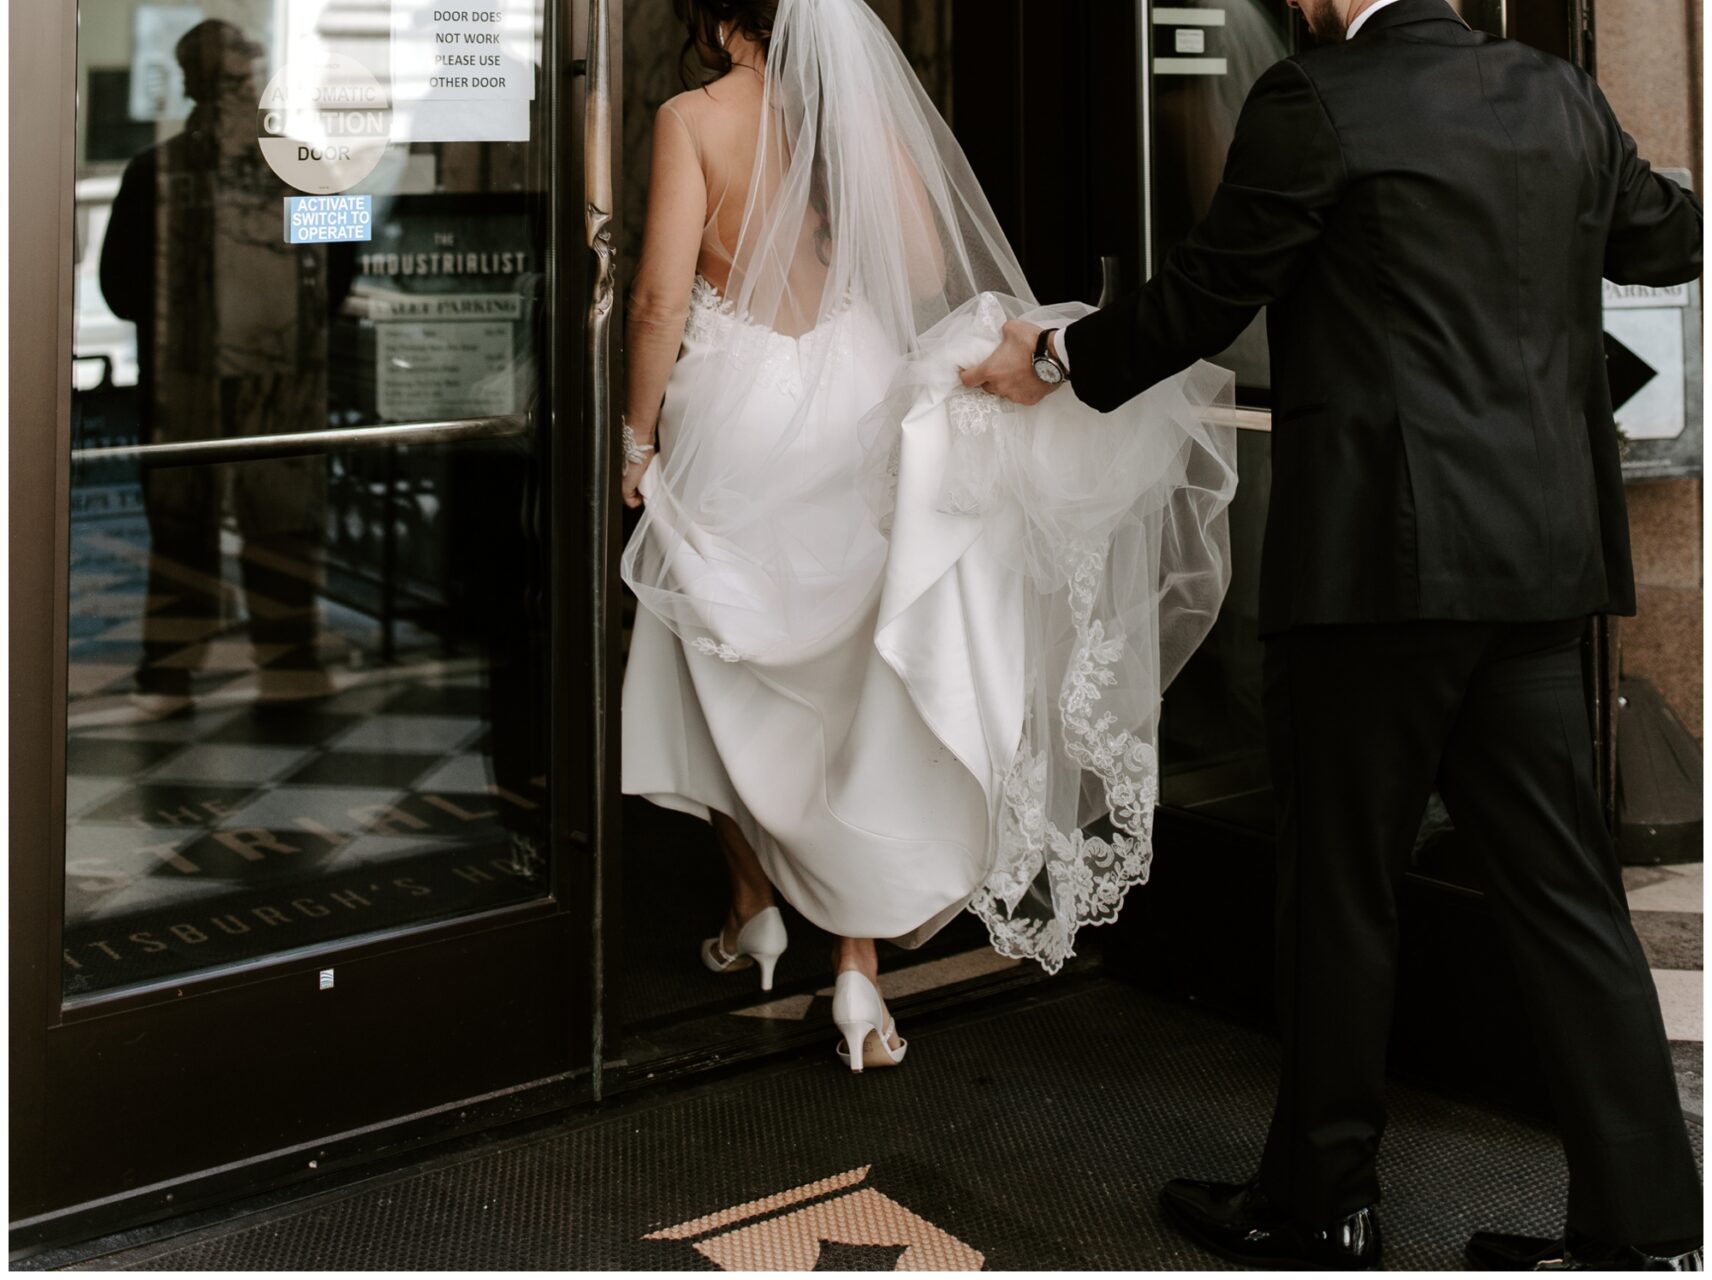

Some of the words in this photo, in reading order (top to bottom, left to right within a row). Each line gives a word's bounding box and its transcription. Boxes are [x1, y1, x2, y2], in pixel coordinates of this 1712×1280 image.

[433, 10, 468, 22] DOOR
[471, 11, 502, 23] DOES
[435, 32, 461, 44] NOT
[463, 32, 500, 45] WORK
[435, 54, 476, 66] PLEASE
[479, 55, 501, 66] USE
[429, 76, 469, 88] OTHER
[471, 77, 506, 88] DOOR
[272, 86, 376, 103] AOMATIC
[297, 145, 351, 162] DOOR
[297, 196, 365, 212] ACTIVATE
[292, 211, 347, 226] SWITCH
[350, 210, 370, 225] TO
[298, 225, 364, 241] OPERATE
